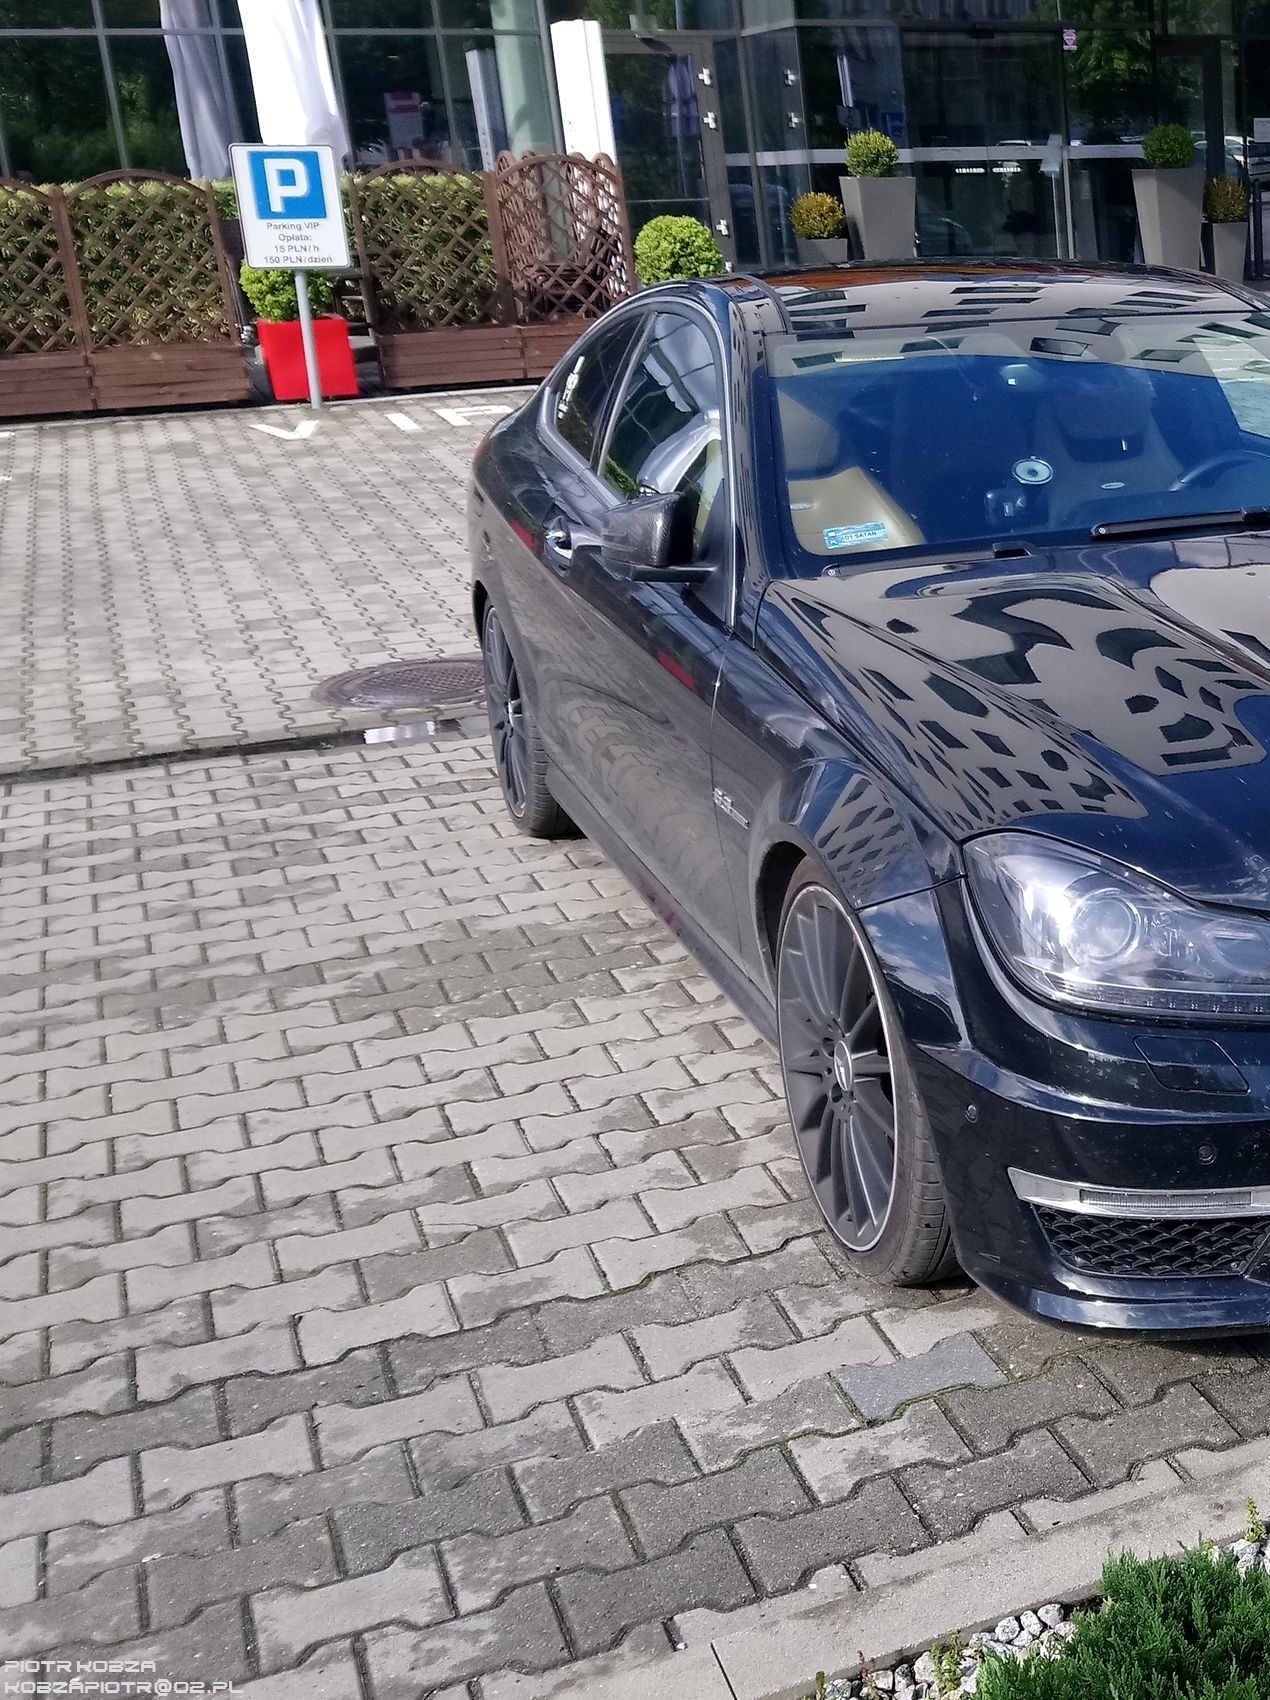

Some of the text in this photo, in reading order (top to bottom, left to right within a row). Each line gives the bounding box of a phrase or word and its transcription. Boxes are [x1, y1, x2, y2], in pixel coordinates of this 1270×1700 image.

[263, 157, 308, 213] P
[266, 222, 320, 231] Parking VIP
[278, 233, 312, 242] Opłata:
[274, 245, 286, 253] 15
[264, 256, 281, 264] 150
